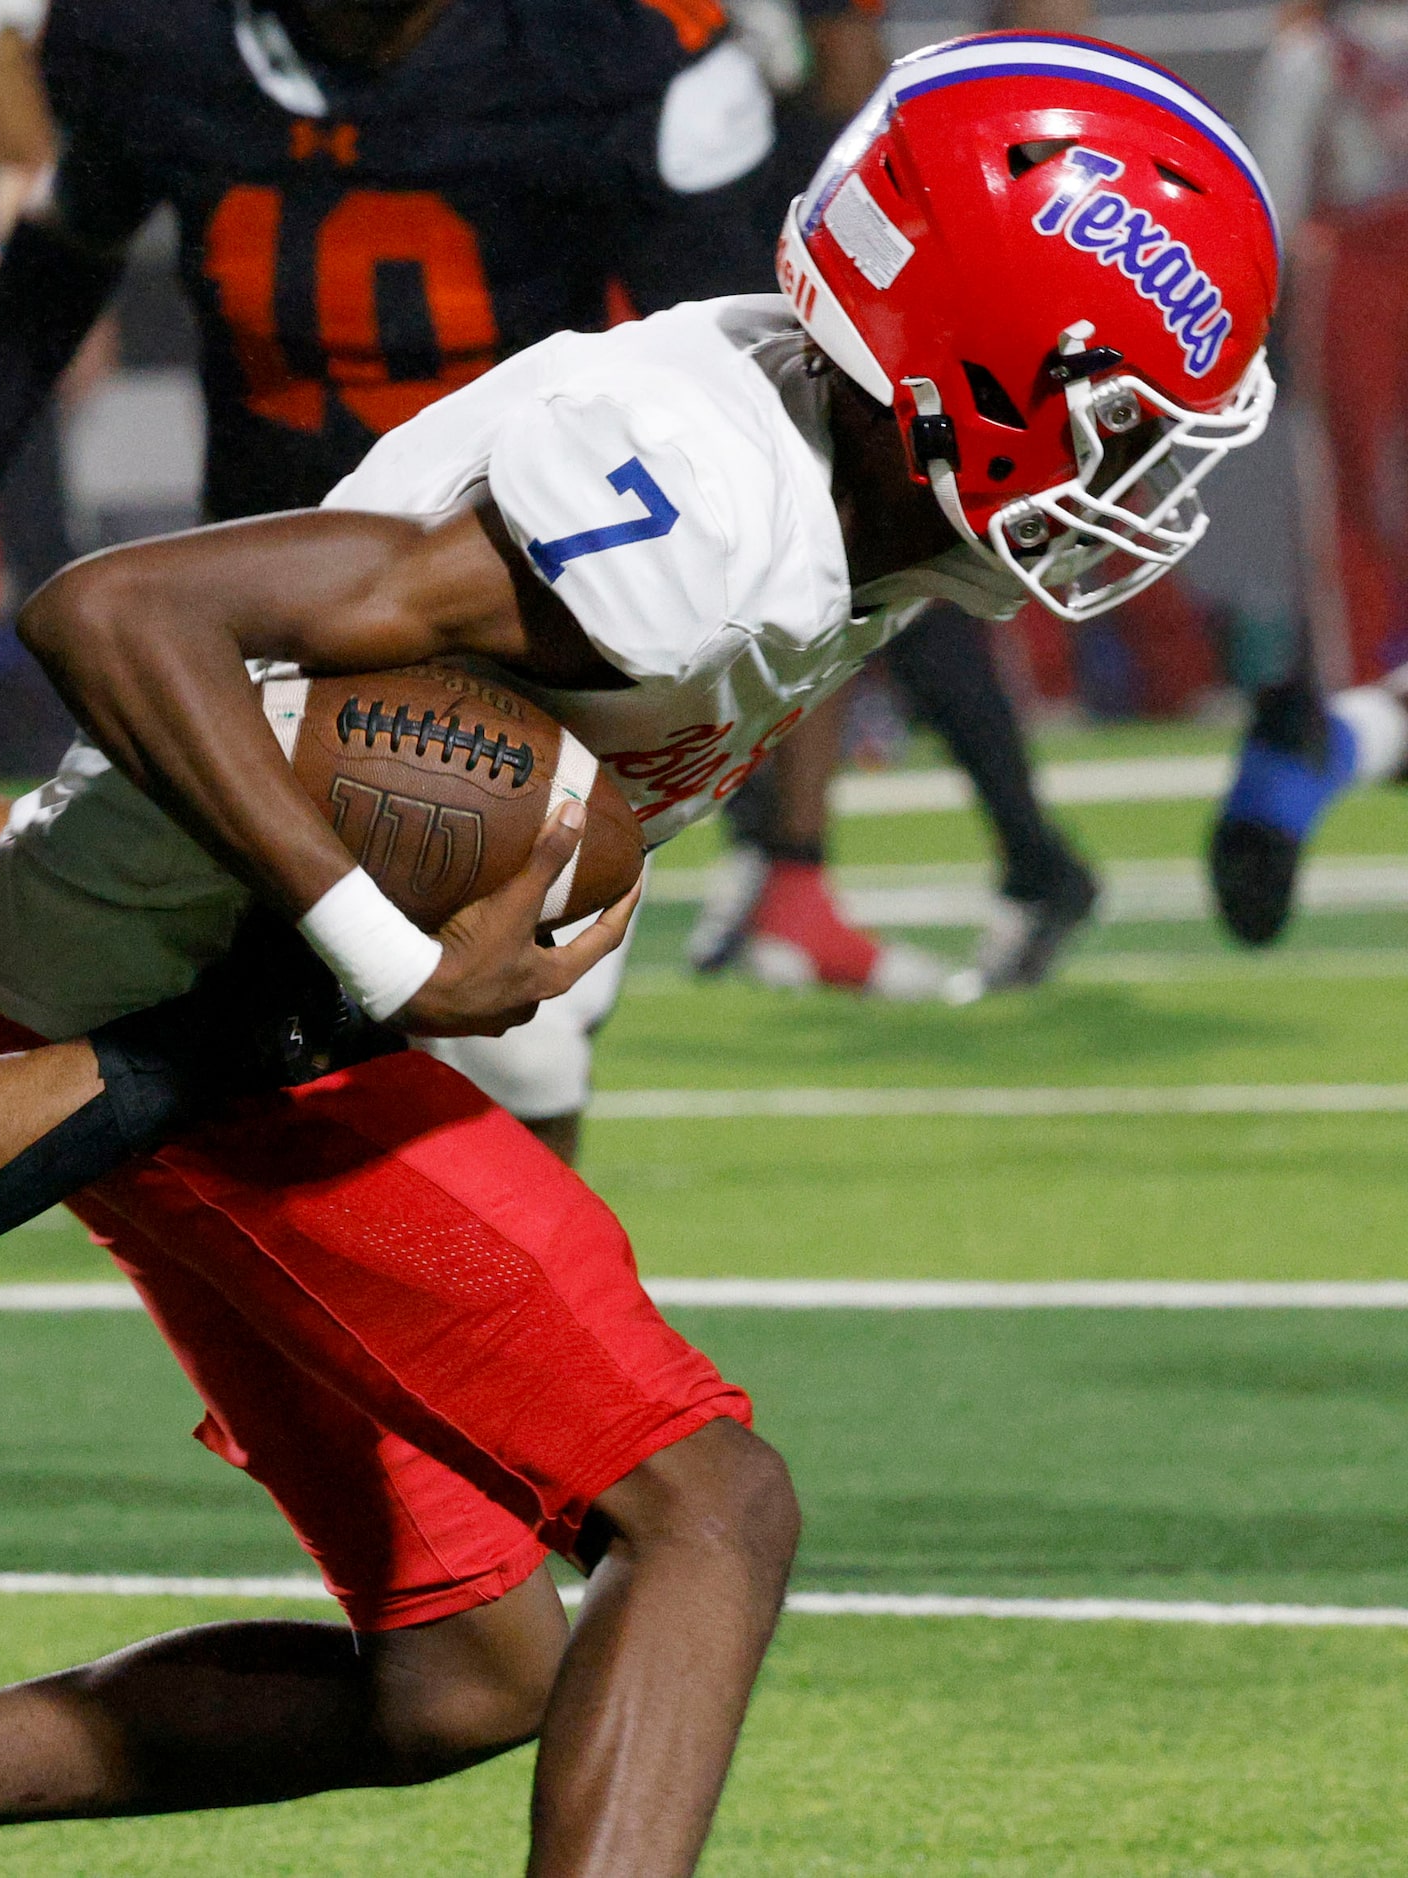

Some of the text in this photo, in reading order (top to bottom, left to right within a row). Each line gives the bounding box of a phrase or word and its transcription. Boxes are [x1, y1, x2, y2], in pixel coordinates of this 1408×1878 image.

[203, 184, 500, 436] 10
[1031, 145, 1233, 379] Texans
[528, 455, 680, 583] 7
